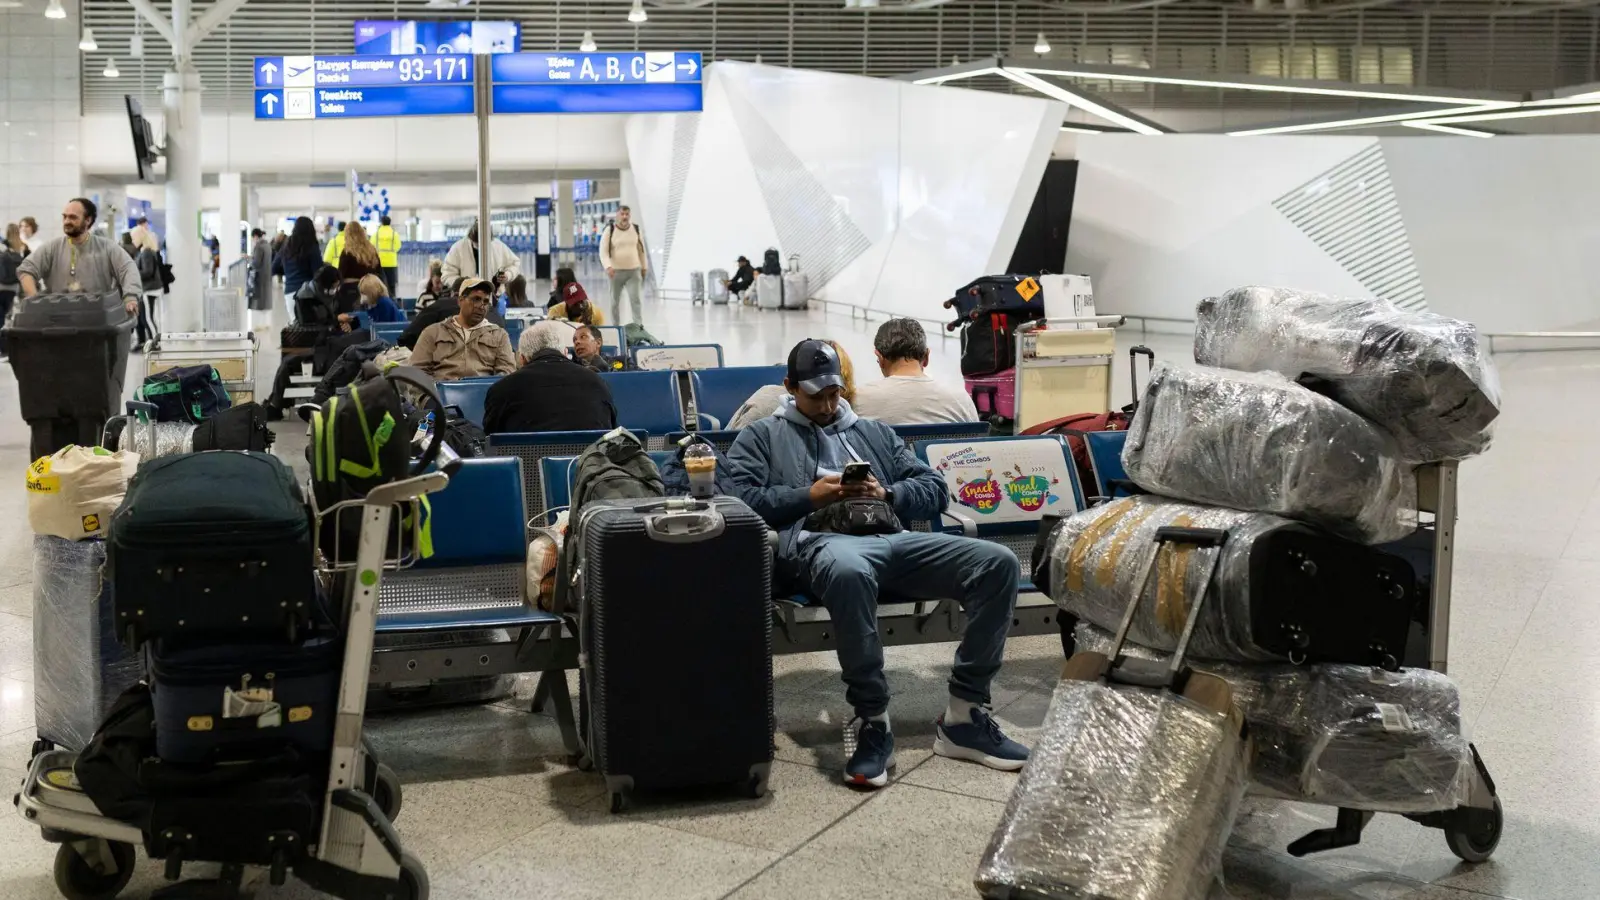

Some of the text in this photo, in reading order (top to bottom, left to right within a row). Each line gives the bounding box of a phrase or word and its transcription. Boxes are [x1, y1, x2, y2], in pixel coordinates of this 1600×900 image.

[399, 57, 467, 81] 93-171
[580, 56, 645, 82] A, B, C
[320, 103, 345, 113] Toilets
[946, 446, 973, 460] DISCOVER
[966, 456, 991, 464] COMBOS
[964, 481, 993, 497] Snack
[1008, 475, 1037, 494] Meal
[978, 500, 993, 508] 9€
[1020, 497, 1039, 507] 15€
